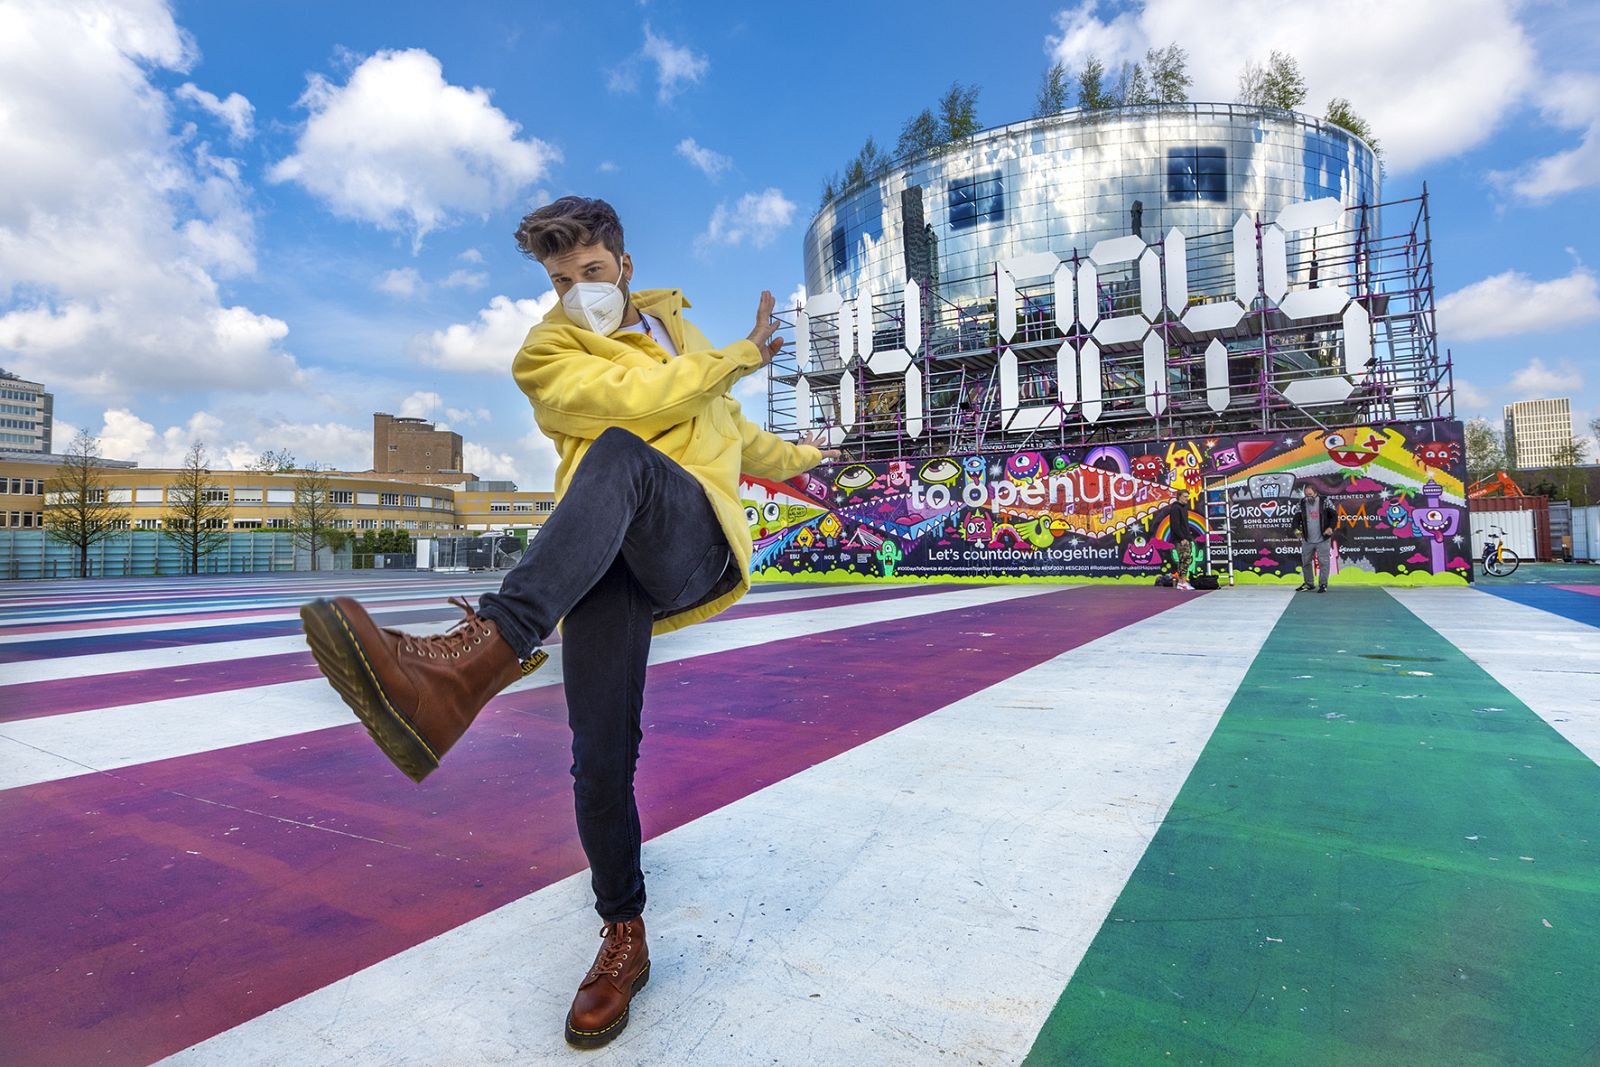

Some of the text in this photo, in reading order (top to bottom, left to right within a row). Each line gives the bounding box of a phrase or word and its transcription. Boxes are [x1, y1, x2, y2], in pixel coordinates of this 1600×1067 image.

[912, 479, 950, 509] to
[928, 545, 1119, 561] Let's countdown together!
